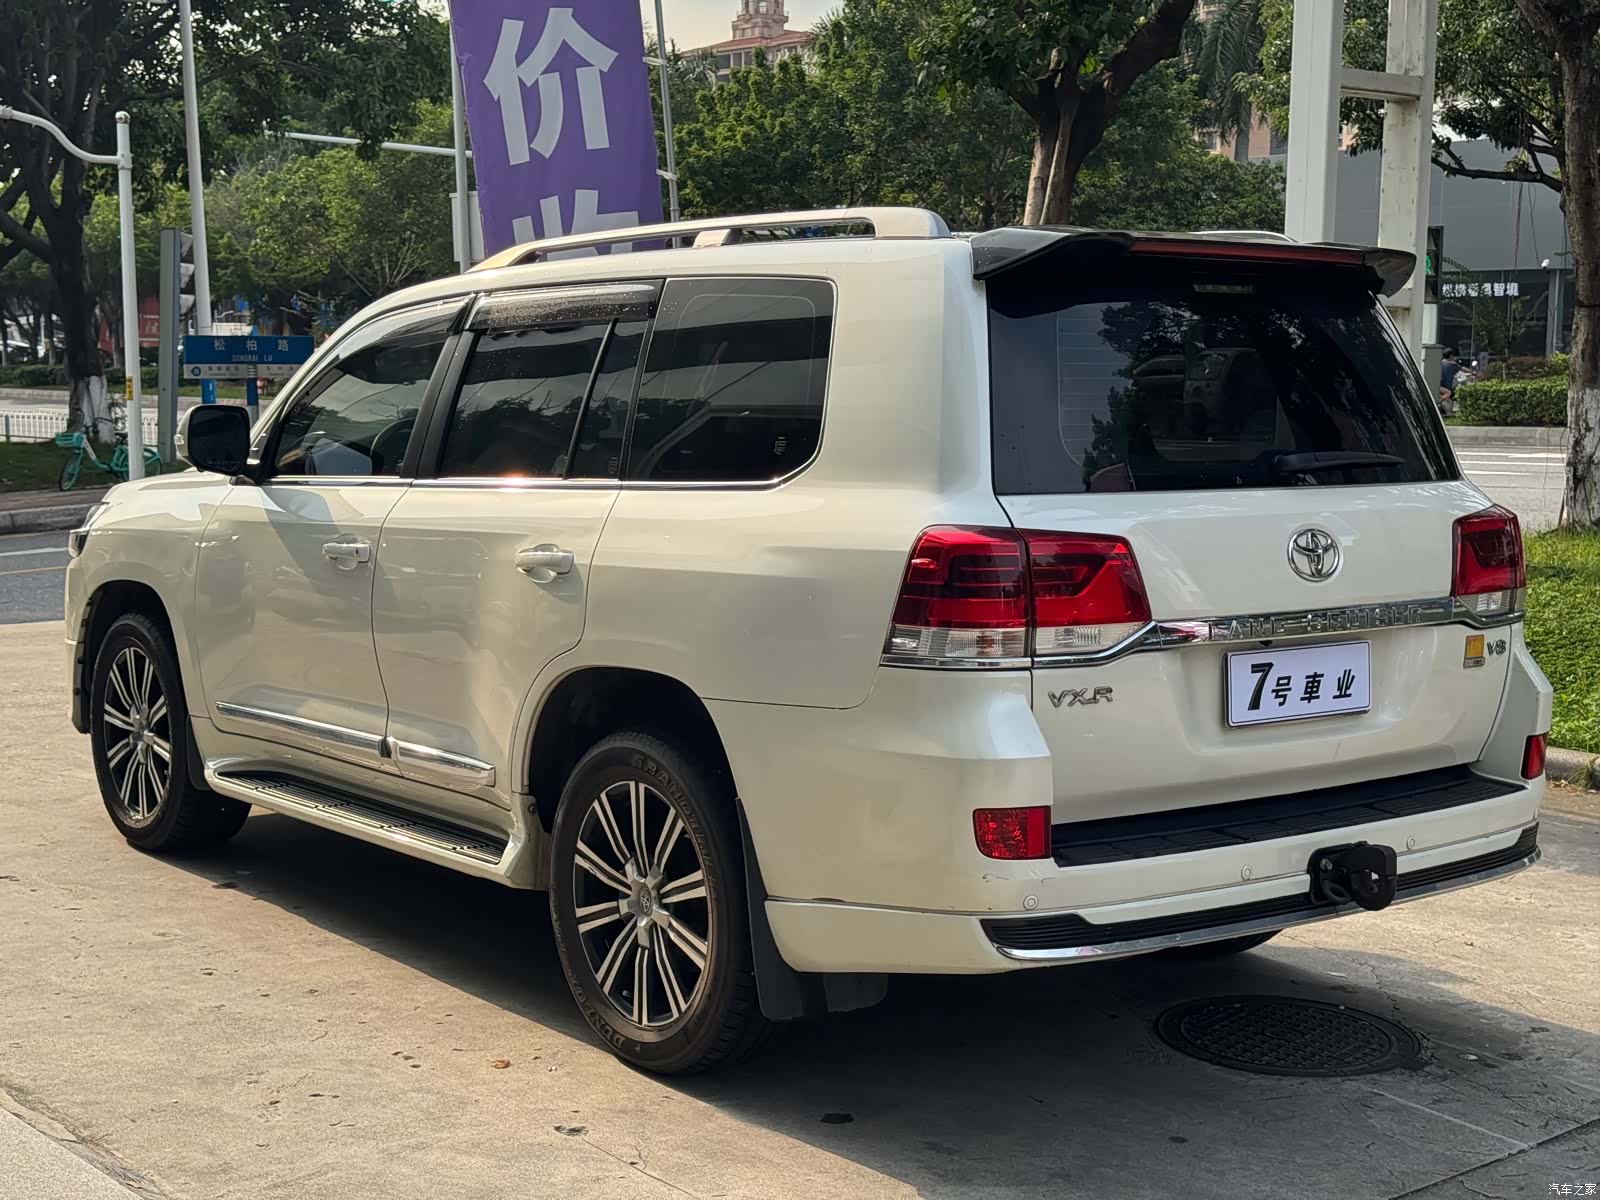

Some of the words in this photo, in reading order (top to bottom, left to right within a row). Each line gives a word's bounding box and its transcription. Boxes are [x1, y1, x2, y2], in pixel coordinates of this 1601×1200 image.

[214, 338, 289, 351] 松柏路
[264, 354, 273, 362] LU
[1207, 615, 1287, 641] LAND
[1306, 604, 1423, 634] CRUISER
[1487, 639, 1507, 656] V8
